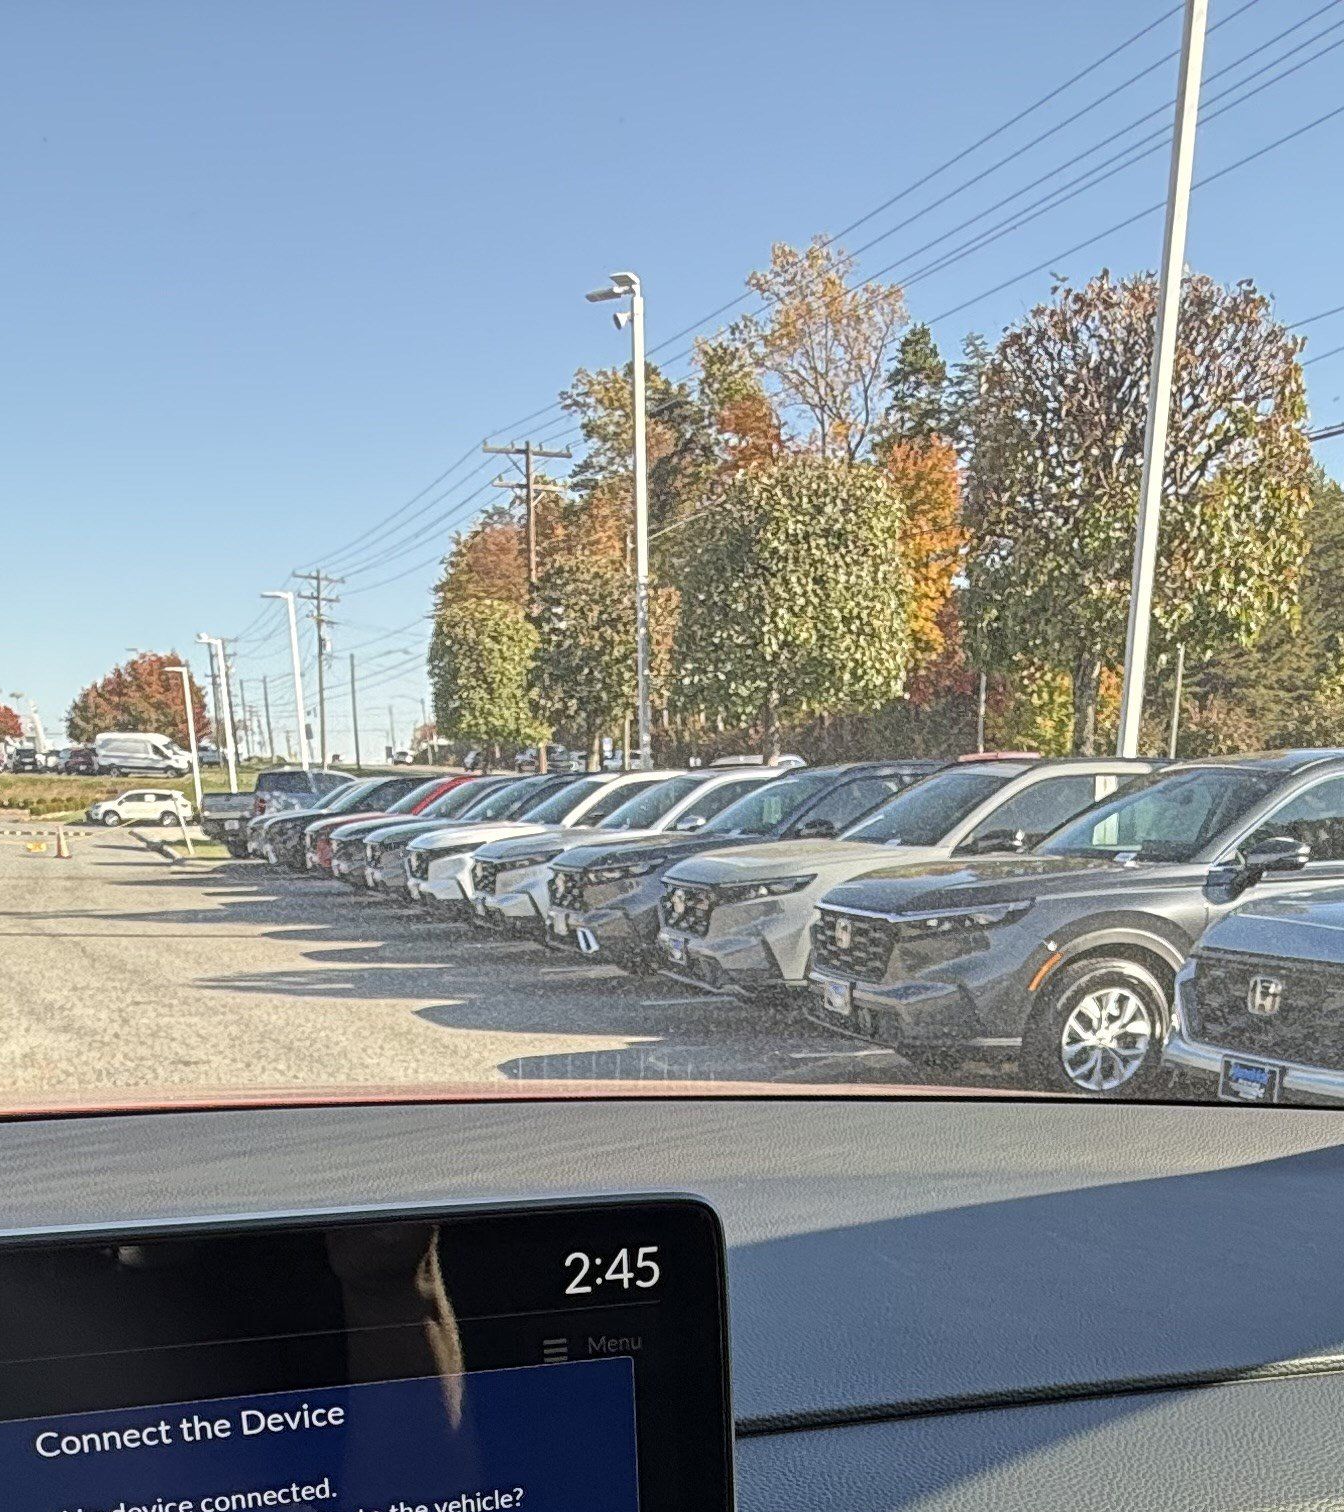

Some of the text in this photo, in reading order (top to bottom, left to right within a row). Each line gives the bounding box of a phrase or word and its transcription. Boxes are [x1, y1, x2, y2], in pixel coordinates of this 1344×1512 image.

[564, 1246, 660, 1295] 2:45
[587, 1336, 644, 1354] Menu
[36, 1403, 345, 1458] Connect the Device
